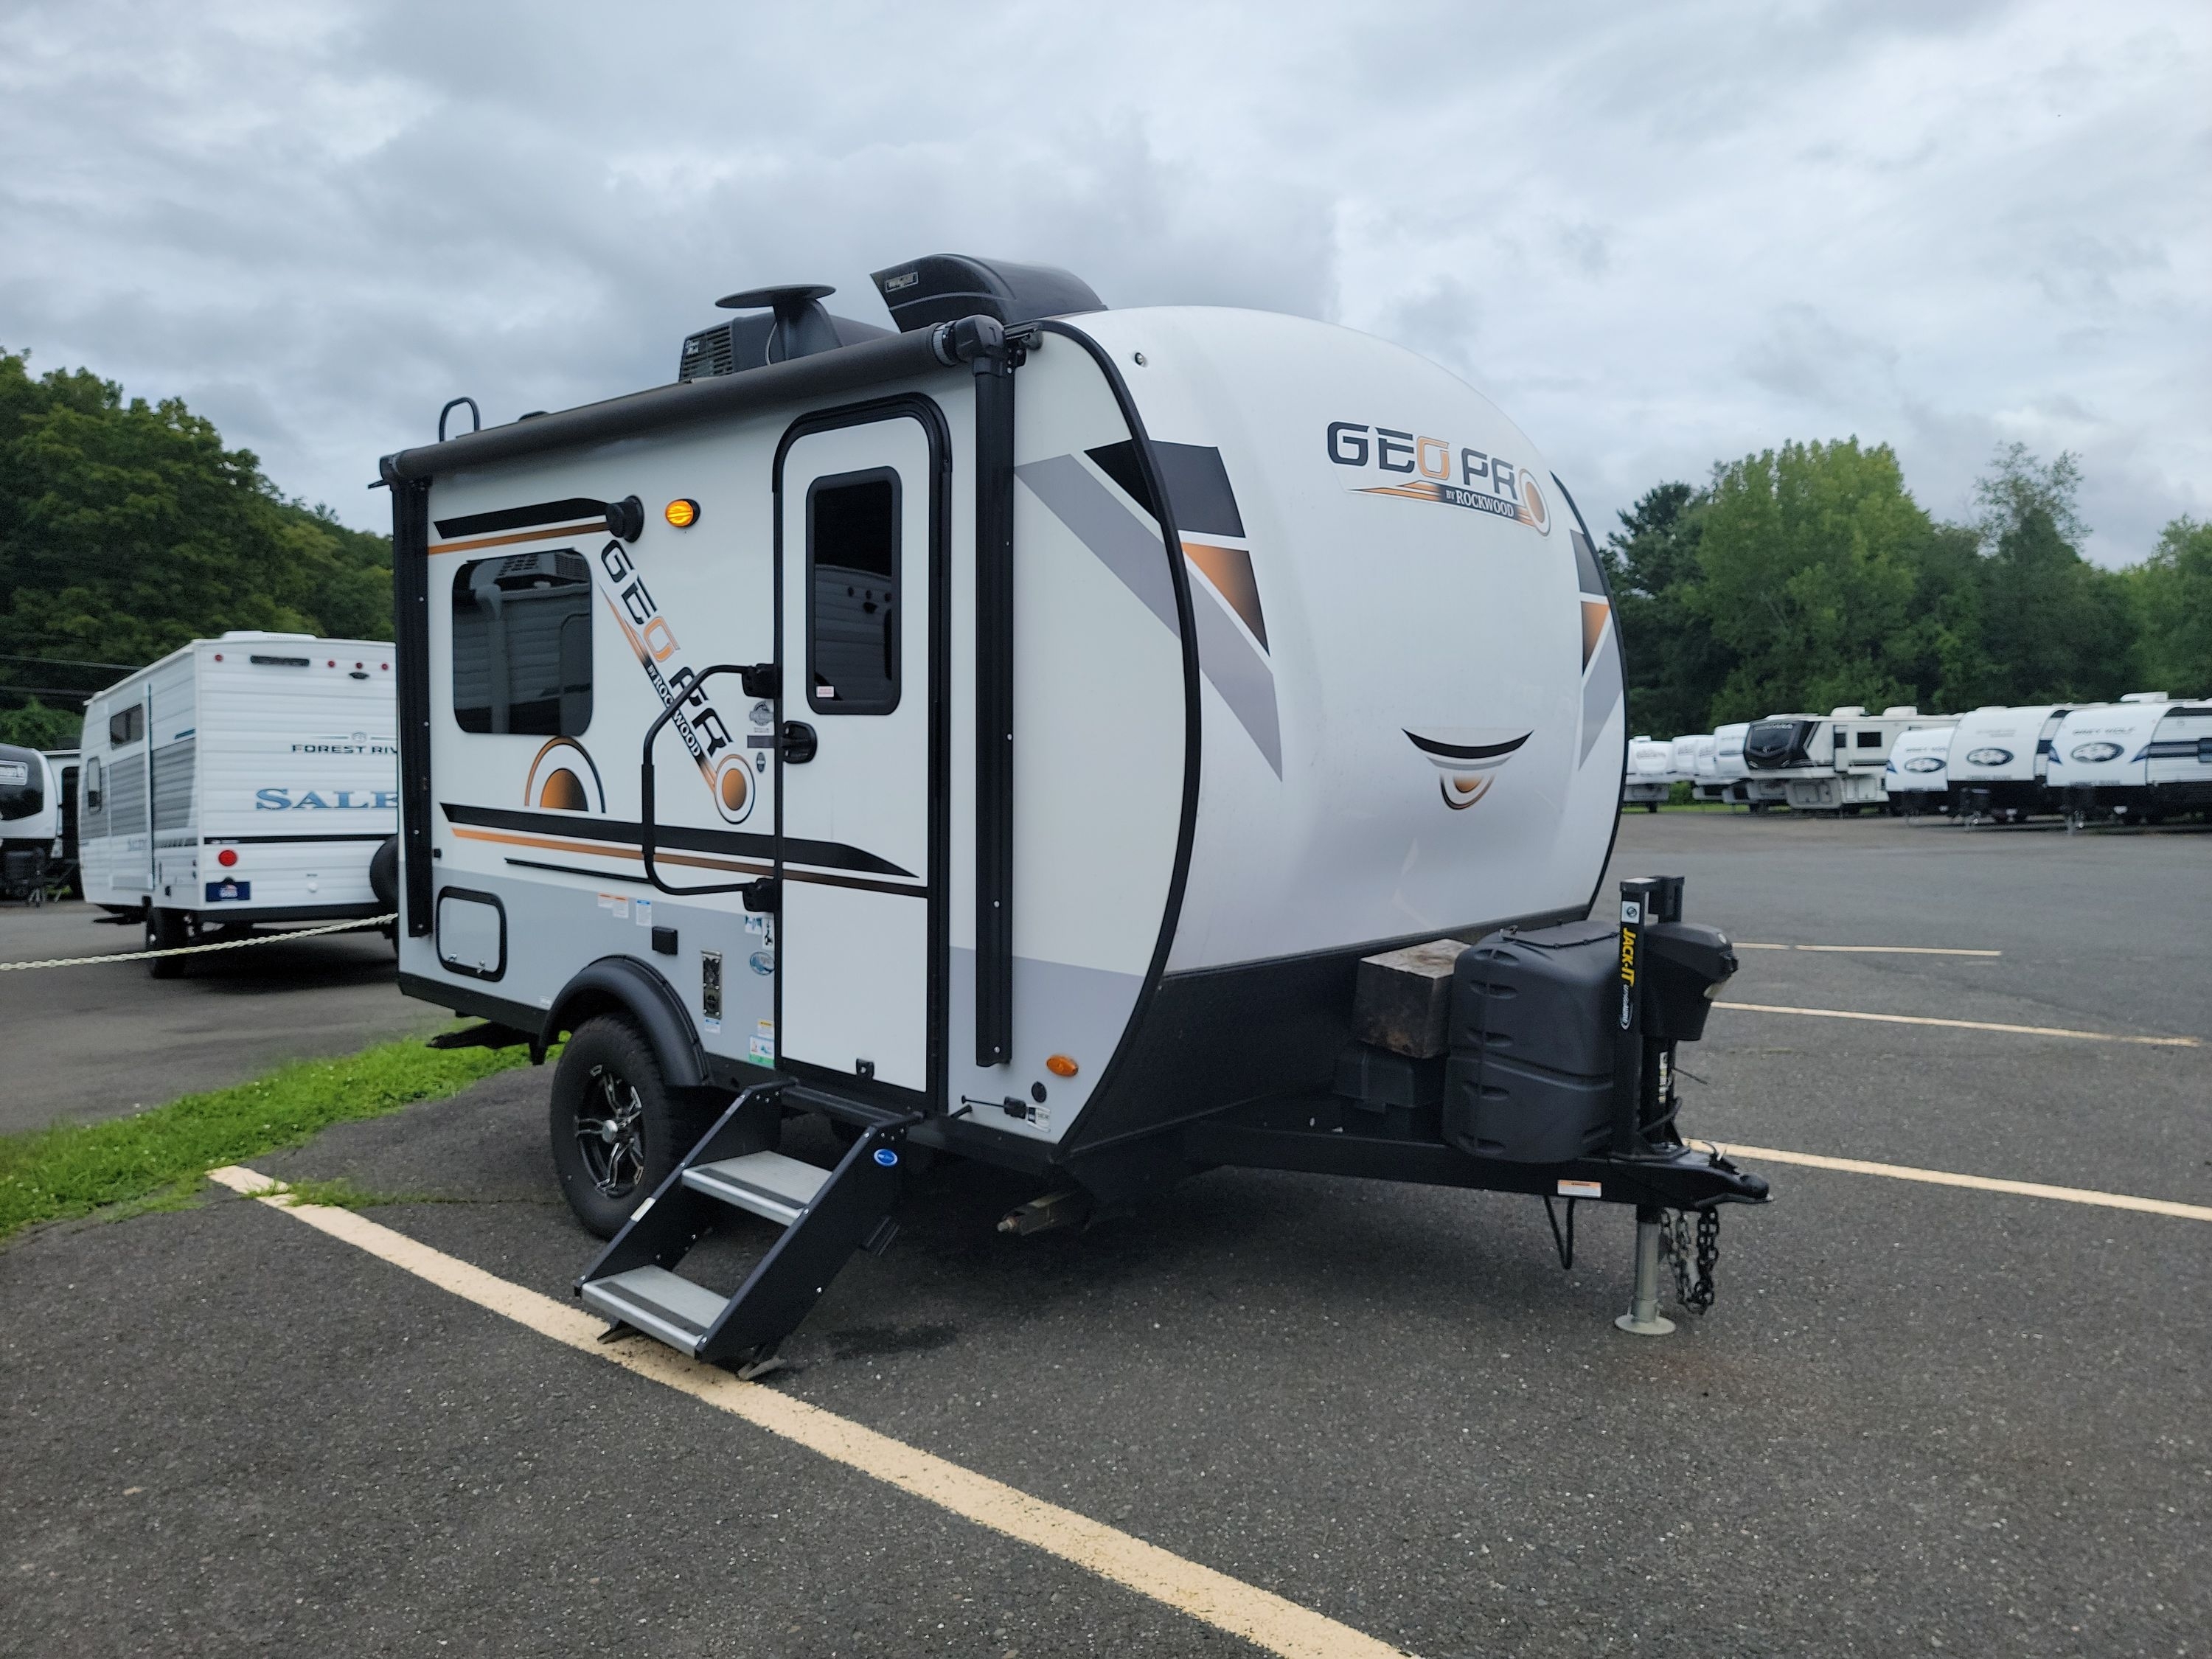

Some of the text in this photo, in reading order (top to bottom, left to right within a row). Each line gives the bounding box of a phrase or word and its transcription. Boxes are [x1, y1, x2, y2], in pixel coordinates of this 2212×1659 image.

[1327, 421, 1551, 537] GEO PRO
[1445, 490, 1514, 518] BY ROCKWOOD
[601, 539, 681, 663] GEO
[292, 744, 364, 754] FOREST
[647, 664, 702, 757] BY ROCWOOD
[1621, 927, 1637, 988] JACK-IT
